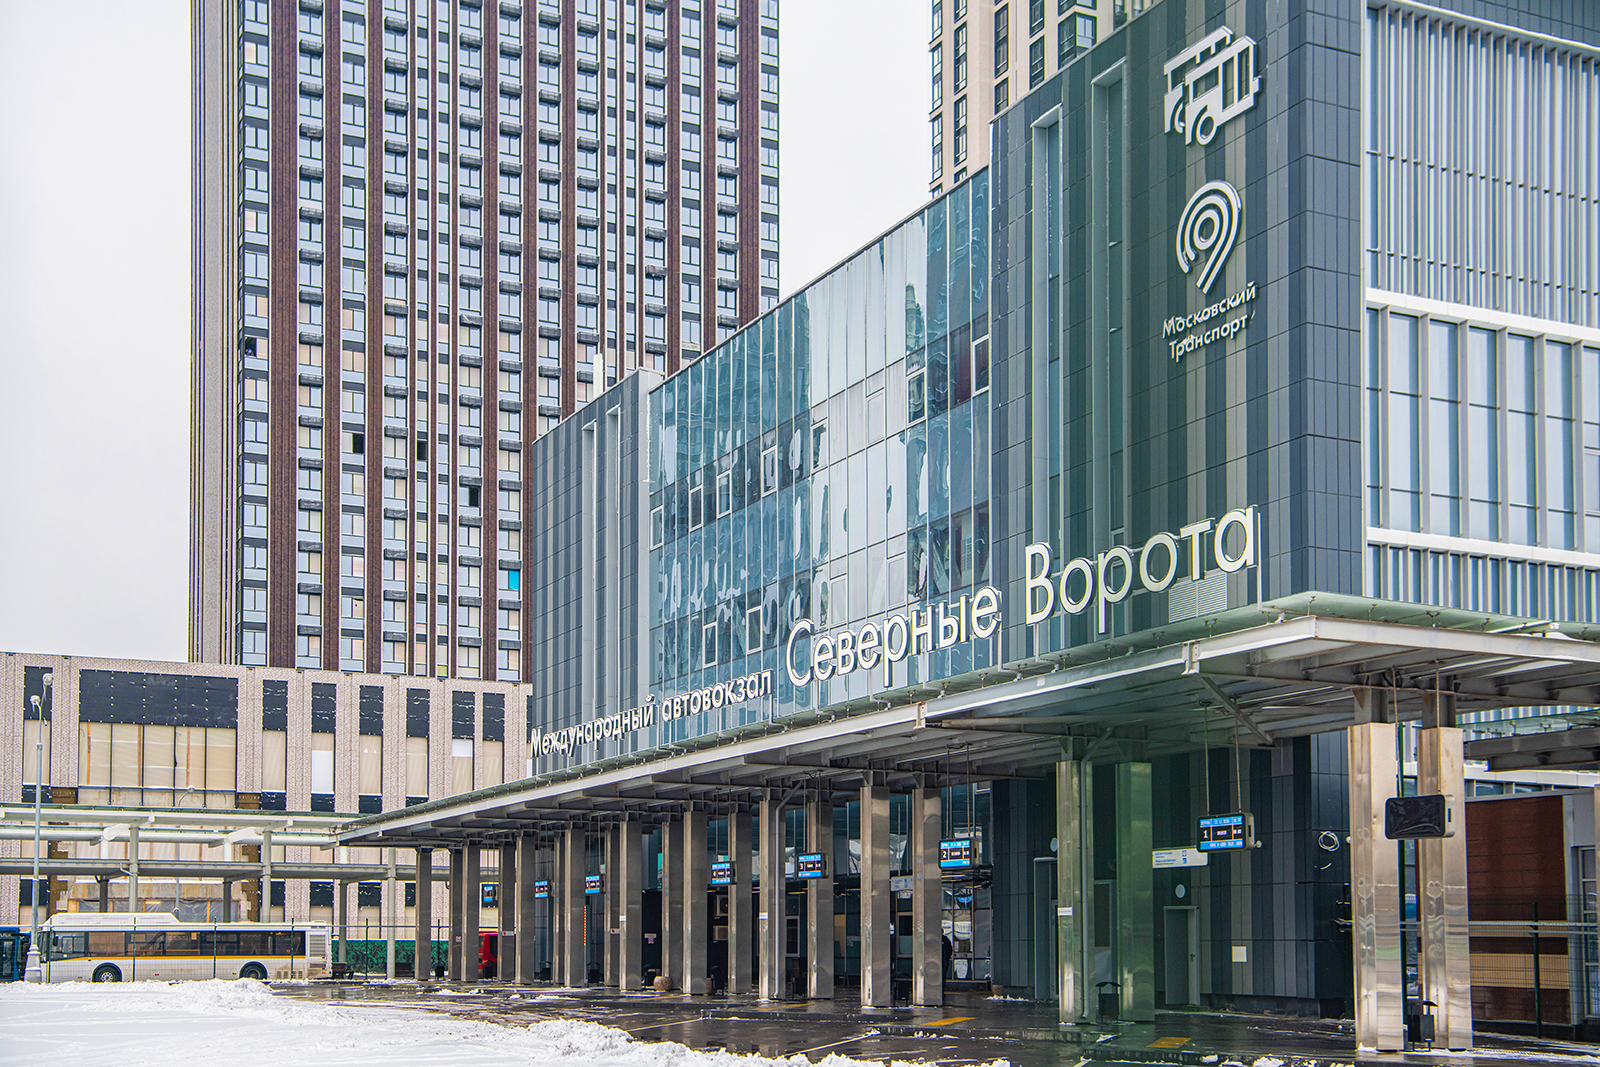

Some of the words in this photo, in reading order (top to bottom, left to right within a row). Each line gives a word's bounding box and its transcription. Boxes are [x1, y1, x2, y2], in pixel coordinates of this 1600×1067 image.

[1162, 281, 1257, 339] Московский
[1169, 314, 1249, 363] Транспорт
[530, 693, 658, 758] Международный
[662, 669, 774, 722] автовокзал
[786, 585, 1001, 688] Северные
[1025, 504, 1258, 634] Ворота
